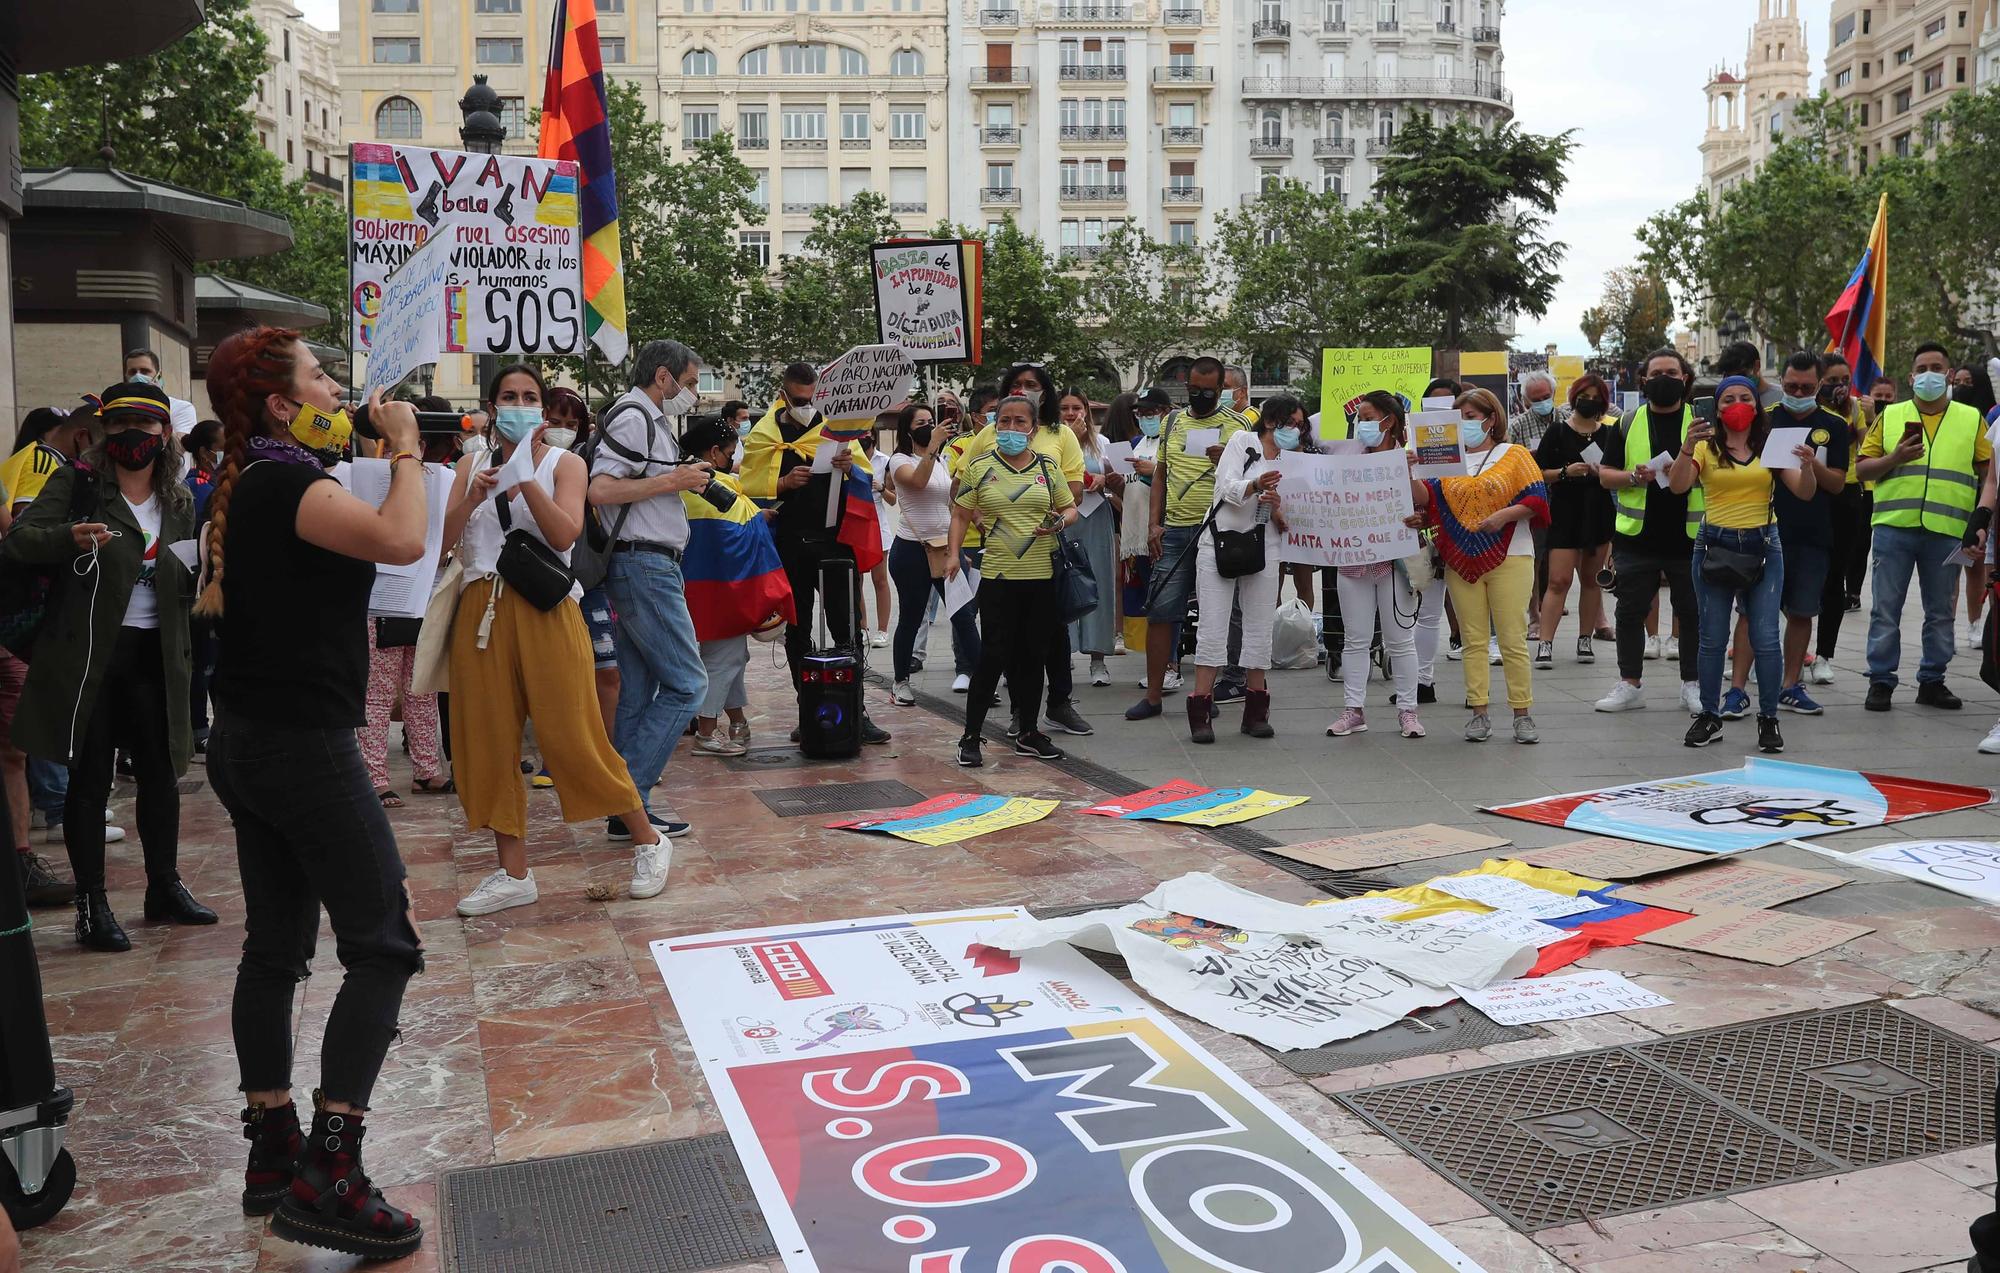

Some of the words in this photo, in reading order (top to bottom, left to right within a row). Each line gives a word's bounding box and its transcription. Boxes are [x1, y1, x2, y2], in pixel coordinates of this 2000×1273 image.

[442, 190, 488, 214] bala
[505, 225, 570, 245] asesino
[450, 245, 531, 270] VIOLADOR
[535, 250, 551, 271] de
[558, 246, 577, 270] los
[935, 253, 951, 270] de
[477, 268, 548, 288] humanos
[908, 283, 920, 295] de
[924, 283, 934, 296] la
[485, 287, 579, 355] SOS
[888, 331, 900, 342] en
[873, 348, 904, 363] VIVA
[1333, 351, 1355, 362] QUE
[1363, 351, 1373, 360] LA
[1382, 350, 1410, 359] GUERRA
[841, 366, 870, 382] PARO
[872, 362, 918, 379] NACIONAL
[1333, 365, 1345, 376] NO
[1352, 365, 1363, 375] TE
[1372, 364, 1388, 375] SEA
[858, 378, 897, 393] ESTAN
[824, 395, 891, 415] MATANDO
[1428, 425, 1445, 434] NO
[1345, 492, 1360, 503] EN
[1288, 531, 1323, 549] MATA
[1331, 536, 1363, 549] MAS
[1368, 532, 1391, 544] QUE
[1397, 528, 1412, 541] EL
[883, 940, 937, 985] VALENCIANA
[899, 929, 963, 983] INTERSINDICAL
